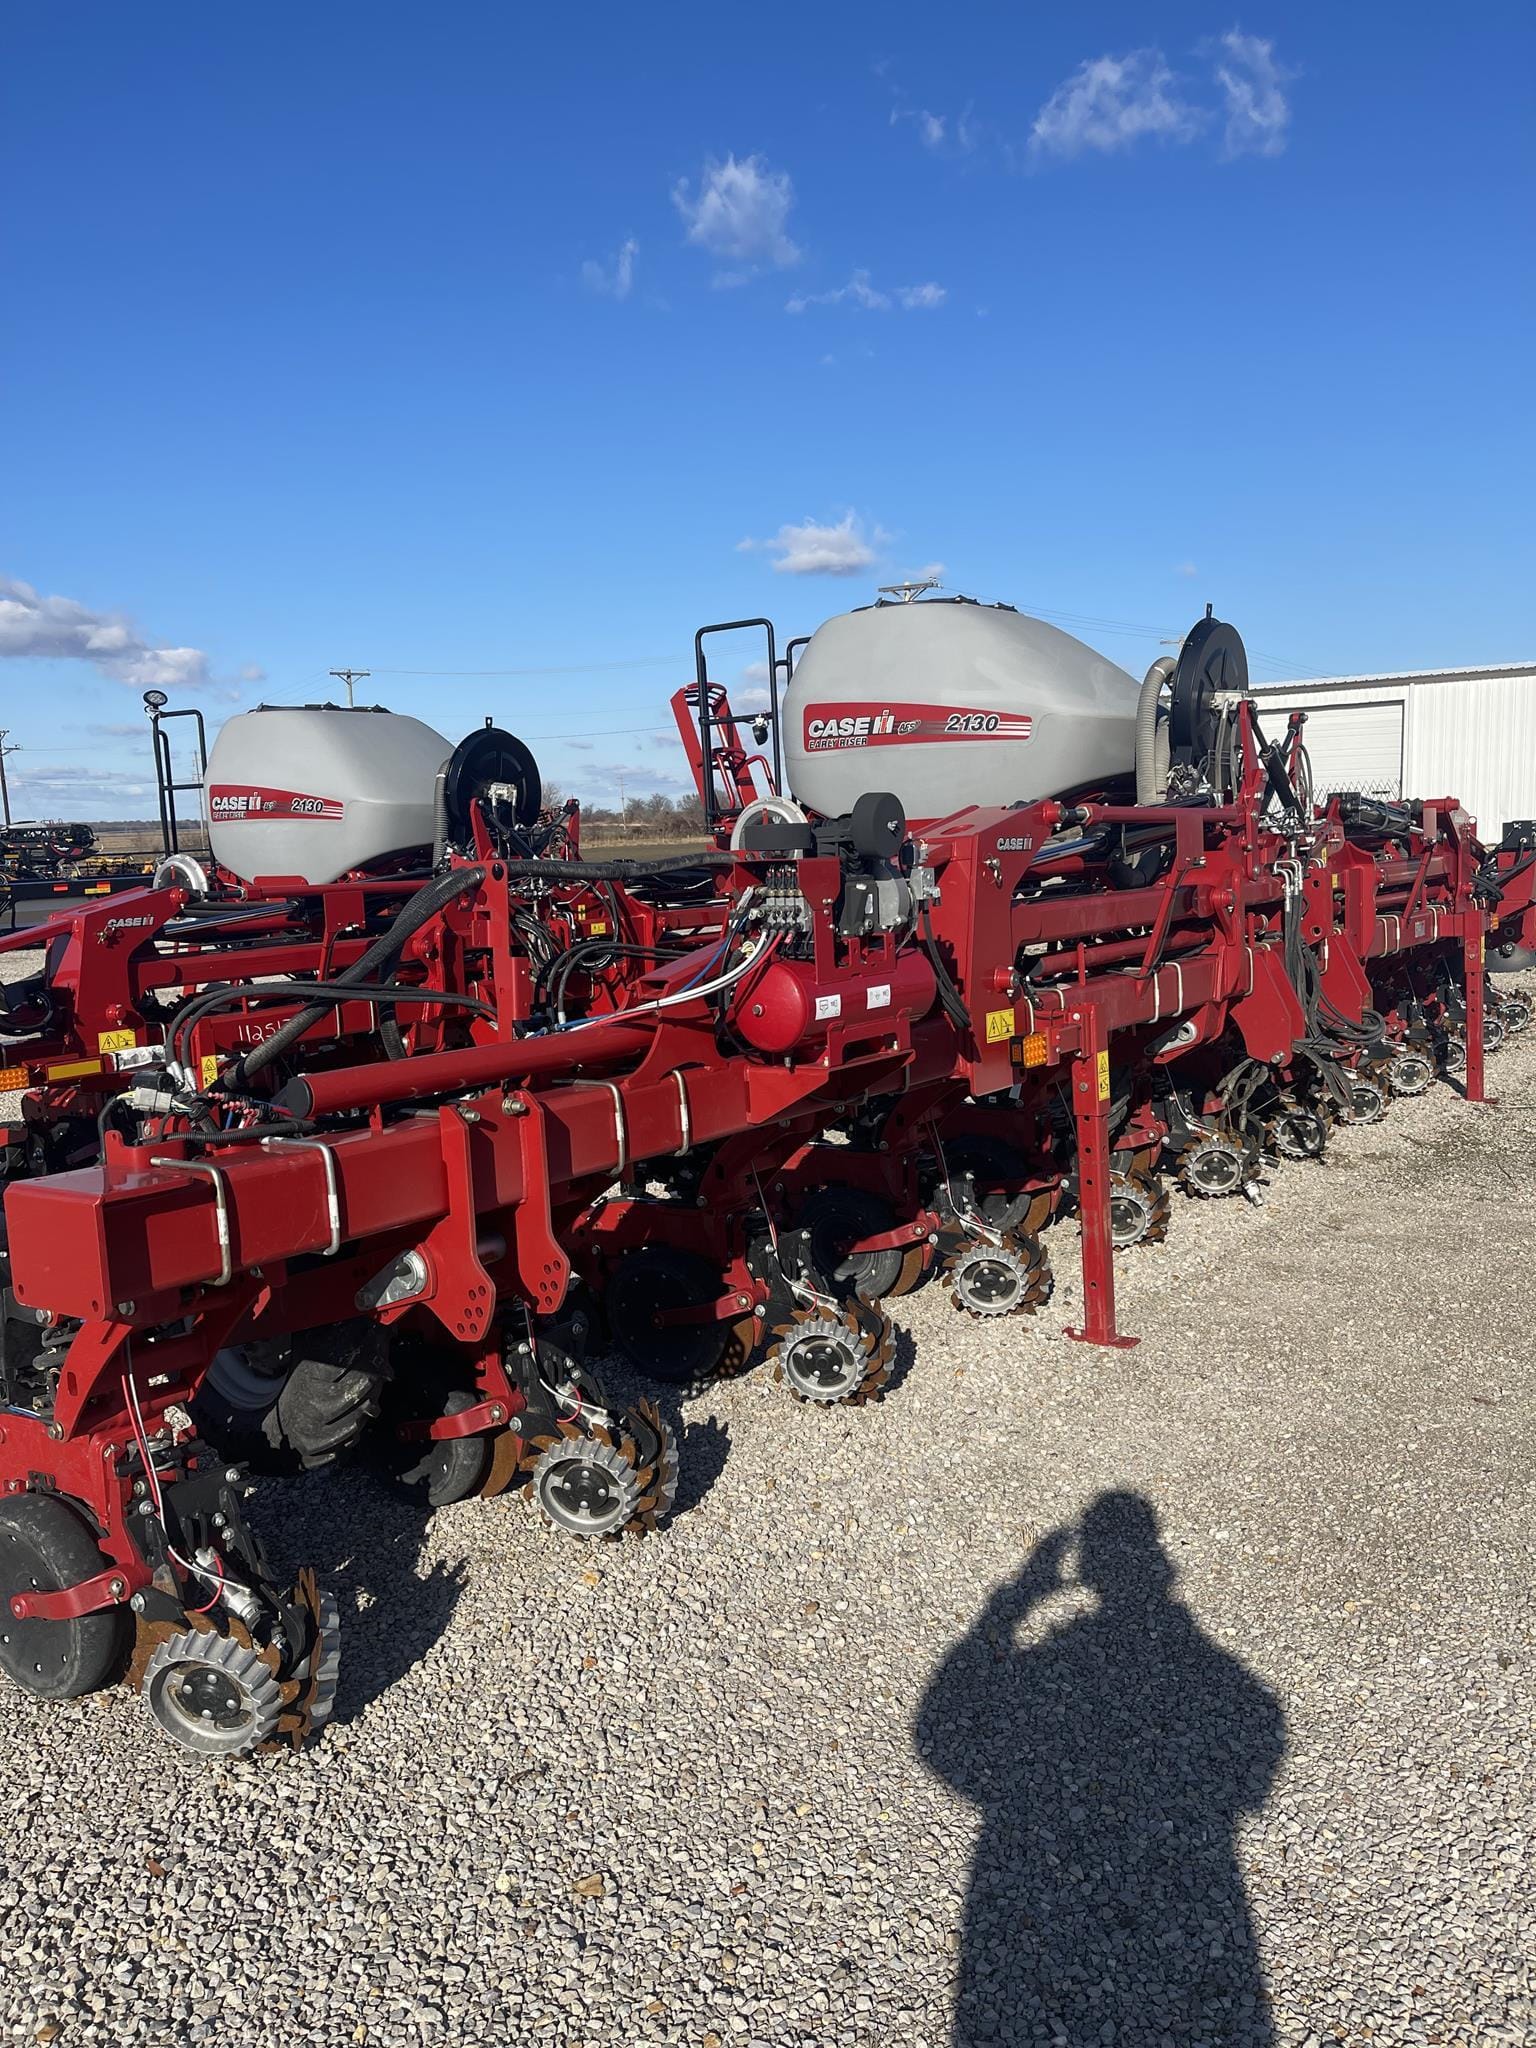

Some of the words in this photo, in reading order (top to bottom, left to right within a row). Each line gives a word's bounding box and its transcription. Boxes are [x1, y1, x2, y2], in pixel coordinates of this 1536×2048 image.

[808, 717, 871, 738] CASE
[945, 714, 1000, 733] 2130
[808, 738, 838, 749] EARLY
[838, 736, 868, 748] RISER
[212, 797, 248, 811] CASE
[291, 797, 324, 814] 2130
[997, 837, 1023, 851] CASE
[107, 917, 142, 928] CASE
